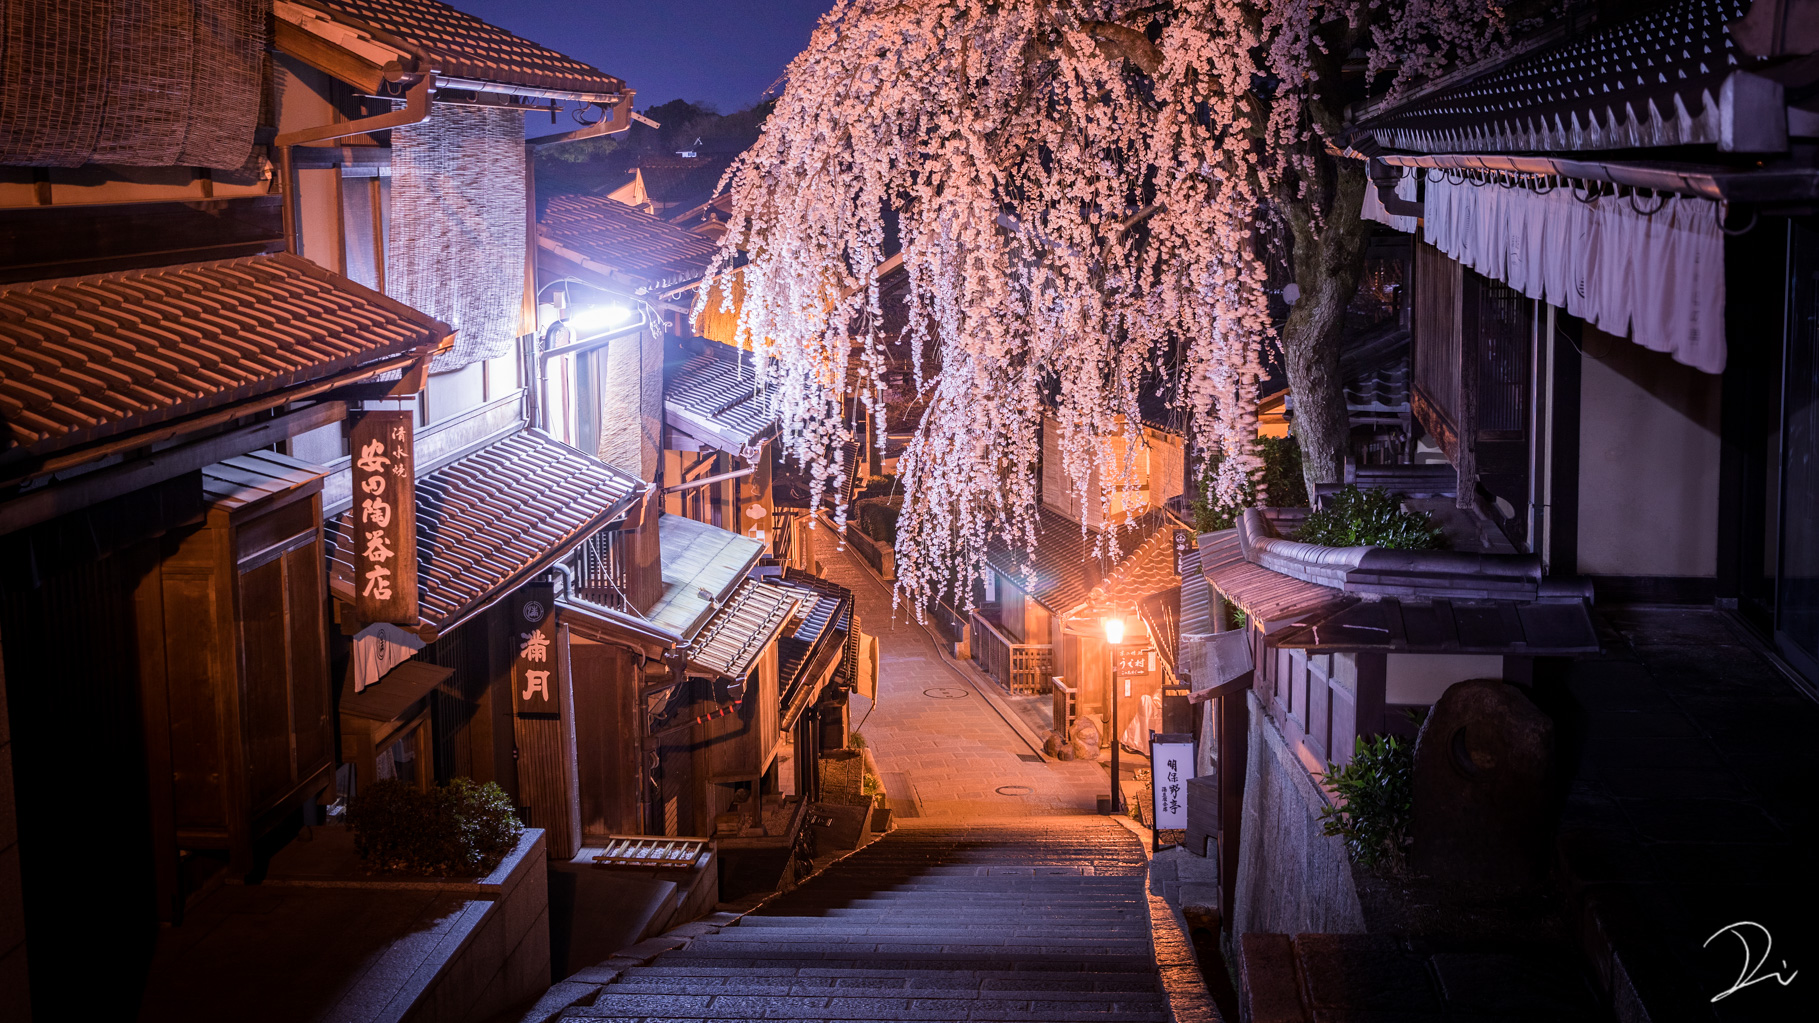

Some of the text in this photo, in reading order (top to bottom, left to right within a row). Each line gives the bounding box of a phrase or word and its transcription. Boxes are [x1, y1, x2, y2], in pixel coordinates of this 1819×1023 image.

[391, 426, 409, 478] 清水焼
[357, 438, 395, 600] 安田陶器店
[520, 629, 551, 702] 満月
[1167, 759, 1181, 815] 明保野亭
